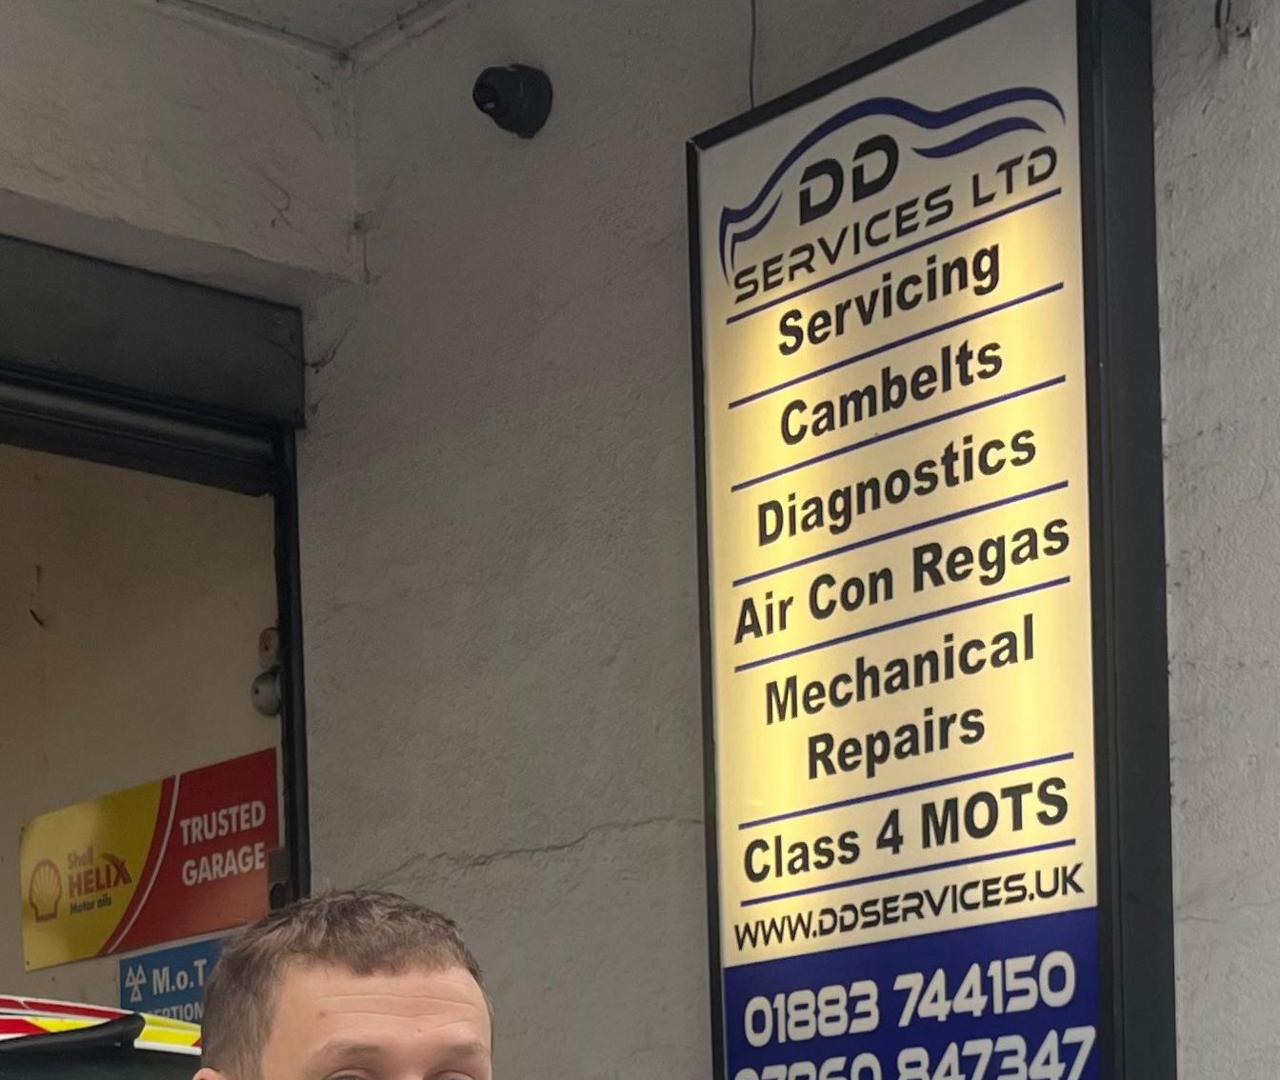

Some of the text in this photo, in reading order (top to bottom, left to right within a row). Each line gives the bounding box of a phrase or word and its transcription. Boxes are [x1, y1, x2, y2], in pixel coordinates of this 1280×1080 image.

[734, 144, 1058, 304] SERVICES LTD
[799, 134, 899, 226] DD
[778, 242, 1000, 356] Servicing
[780, 340, 1003, 446] Cambelts
[757, 429, 1037, 547] Diagnostics
[734, 518, 1070, 645] Air Con Regas
[765, 614, 1034, 725] Mechanical
[808, 707, 985, 780] Repairs
[68, 847, 95, 869] Shell
[180, 800, 266, 846] TRUSTED
[181, 842, 266, 887] GARAGE
[743, 776, 1068, 883] Class 4 MOTS
[68, 853, 133, 898] HELIX
[734, 862, 1085, 951] WWW.DDSERVICES.UK
[744, 950, 1076, 1048] 01883 744150
